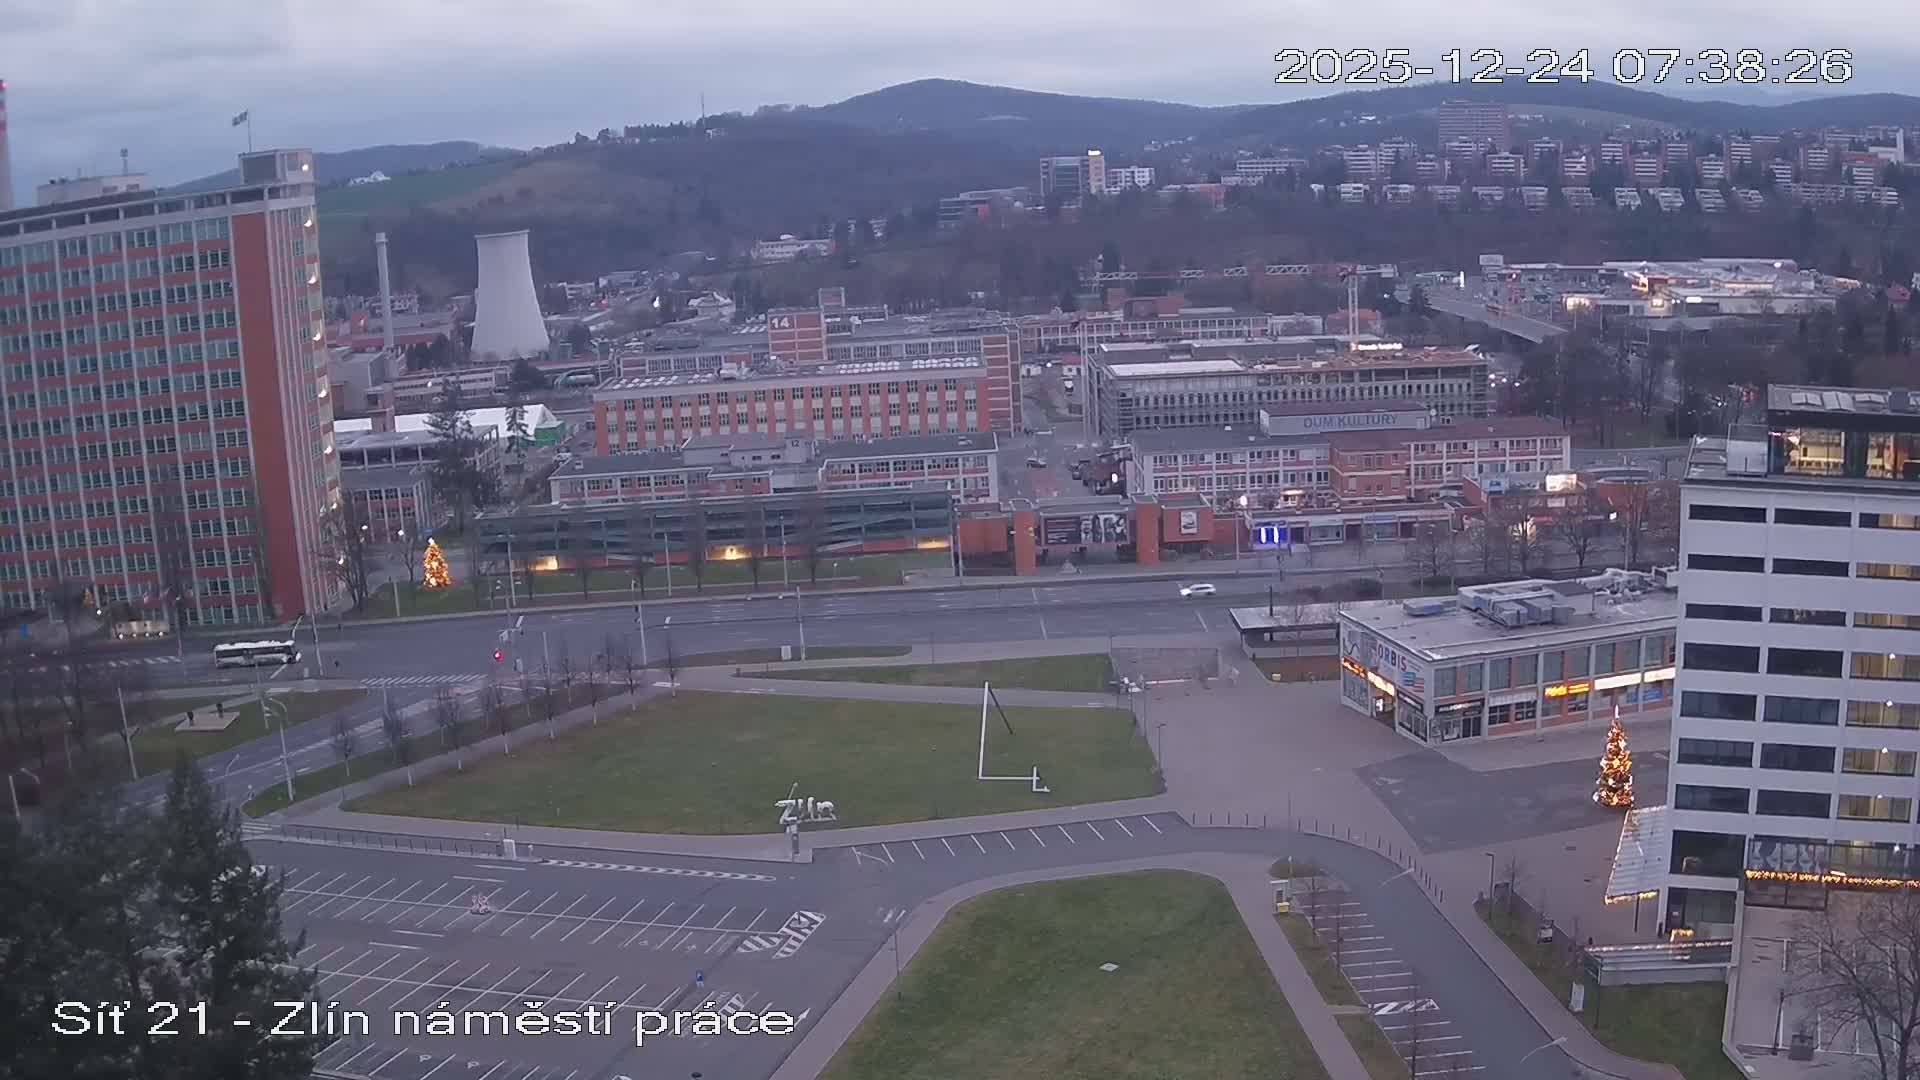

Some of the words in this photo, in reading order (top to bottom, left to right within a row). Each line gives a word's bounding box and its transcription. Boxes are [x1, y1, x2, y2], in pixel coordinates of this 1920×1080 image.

[771, 316, 790, 329] 14
[1337, 413, 1399, 427] KULTURY
[1376, 642, 1408, 673] ORBIS
